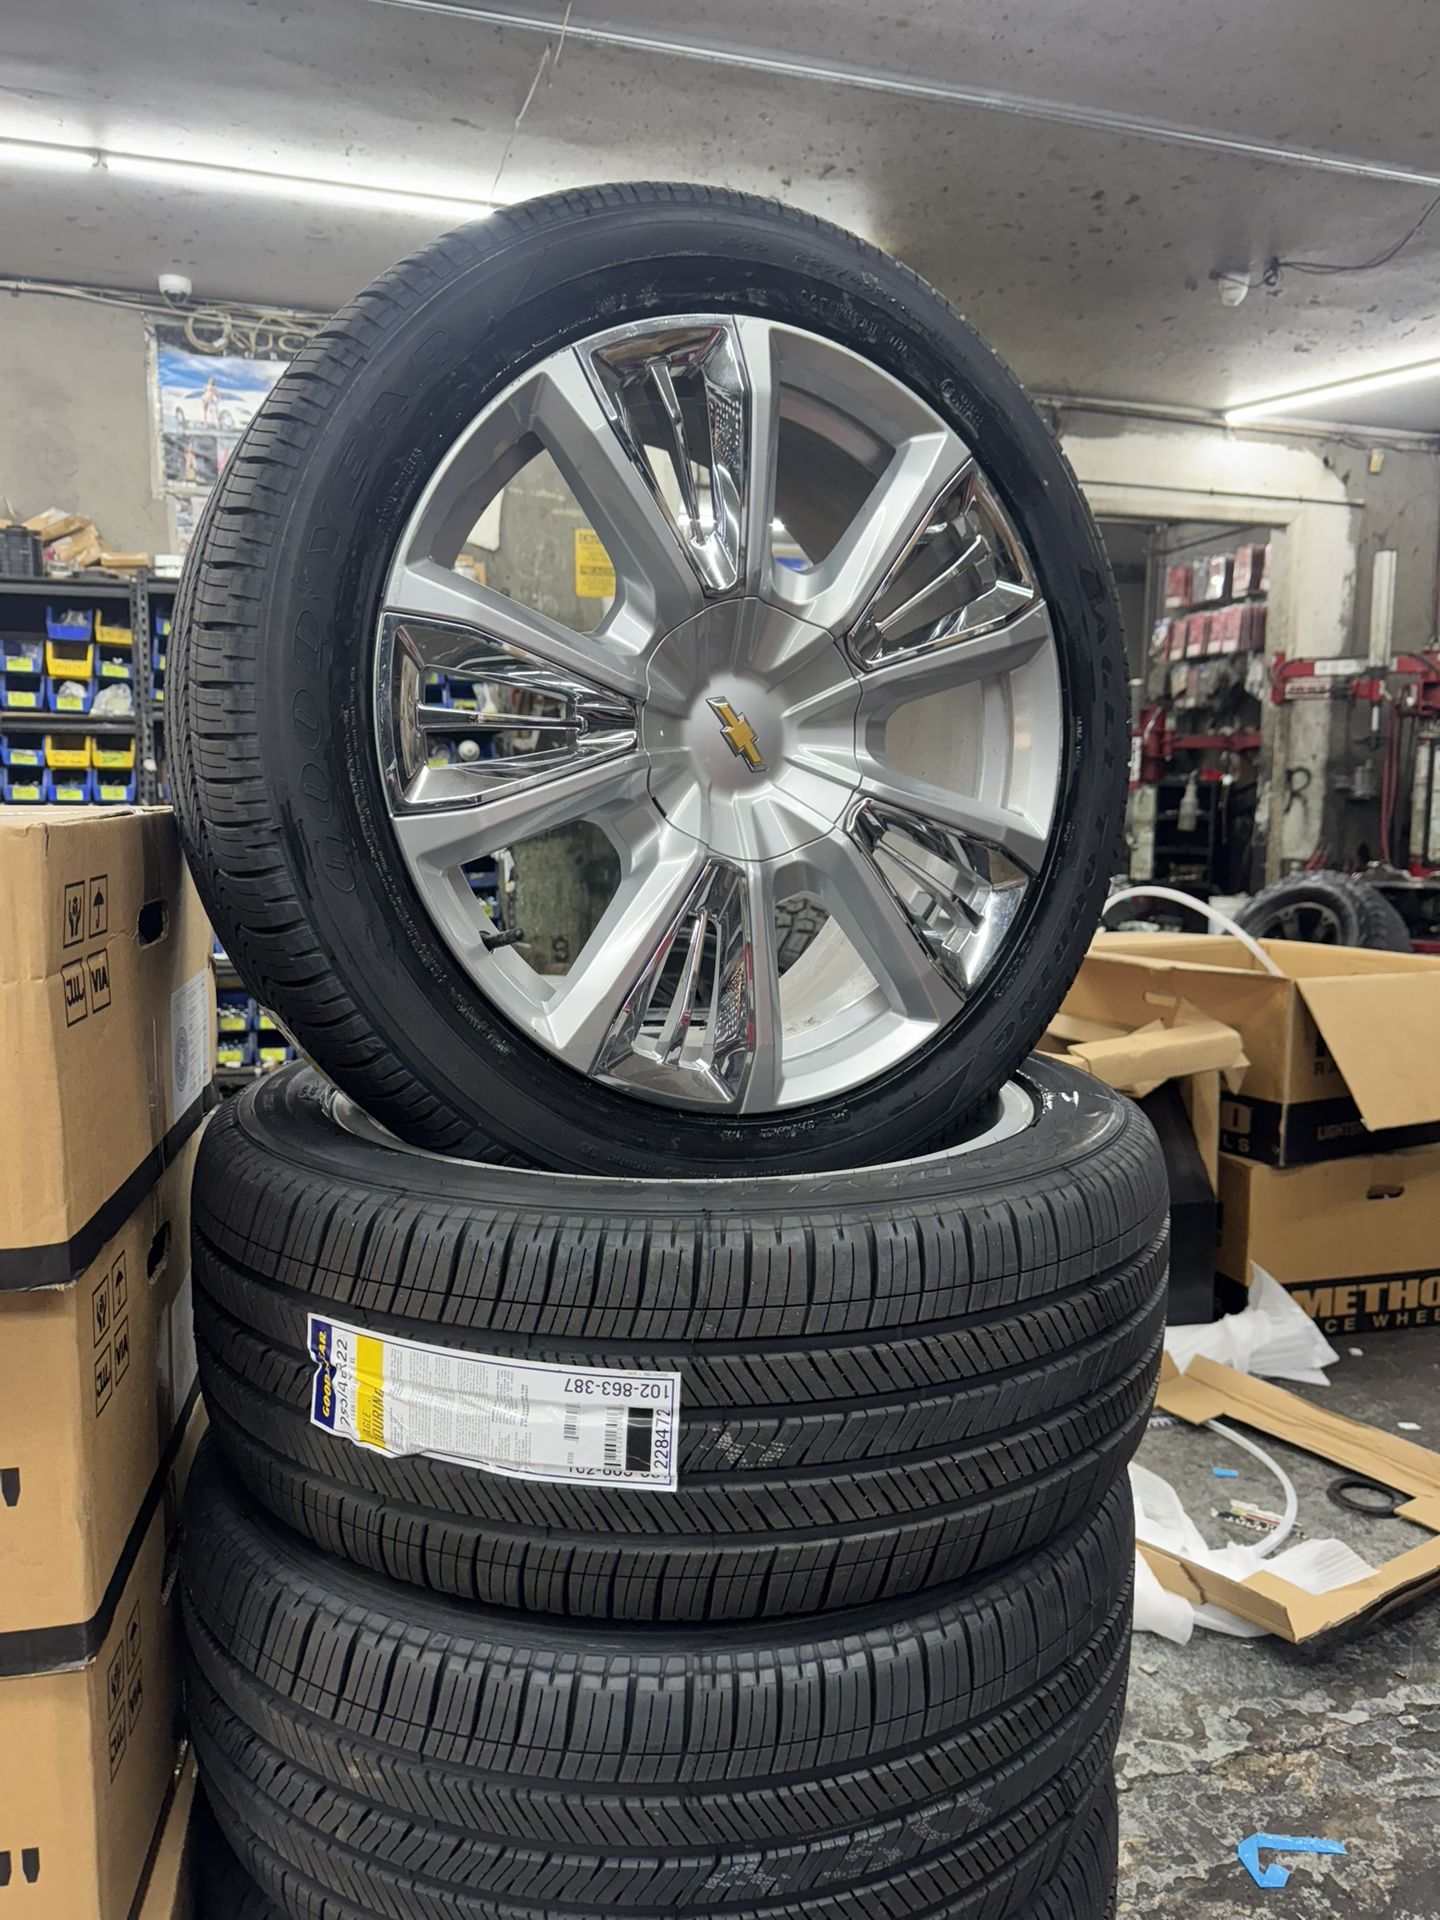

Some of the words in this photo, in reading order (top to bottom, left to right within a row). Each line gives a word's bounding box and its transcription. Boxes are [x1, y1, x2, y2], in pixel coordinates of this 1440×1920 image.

[90, 968, 109, 993] VIA
[114, 1338, 130, 1366] VIA
[563, 1377, 670, 1400] 102-863-387
[362, 1410, 373, 1437] AGLE
[653, 1408, 672, 1470] 228472
